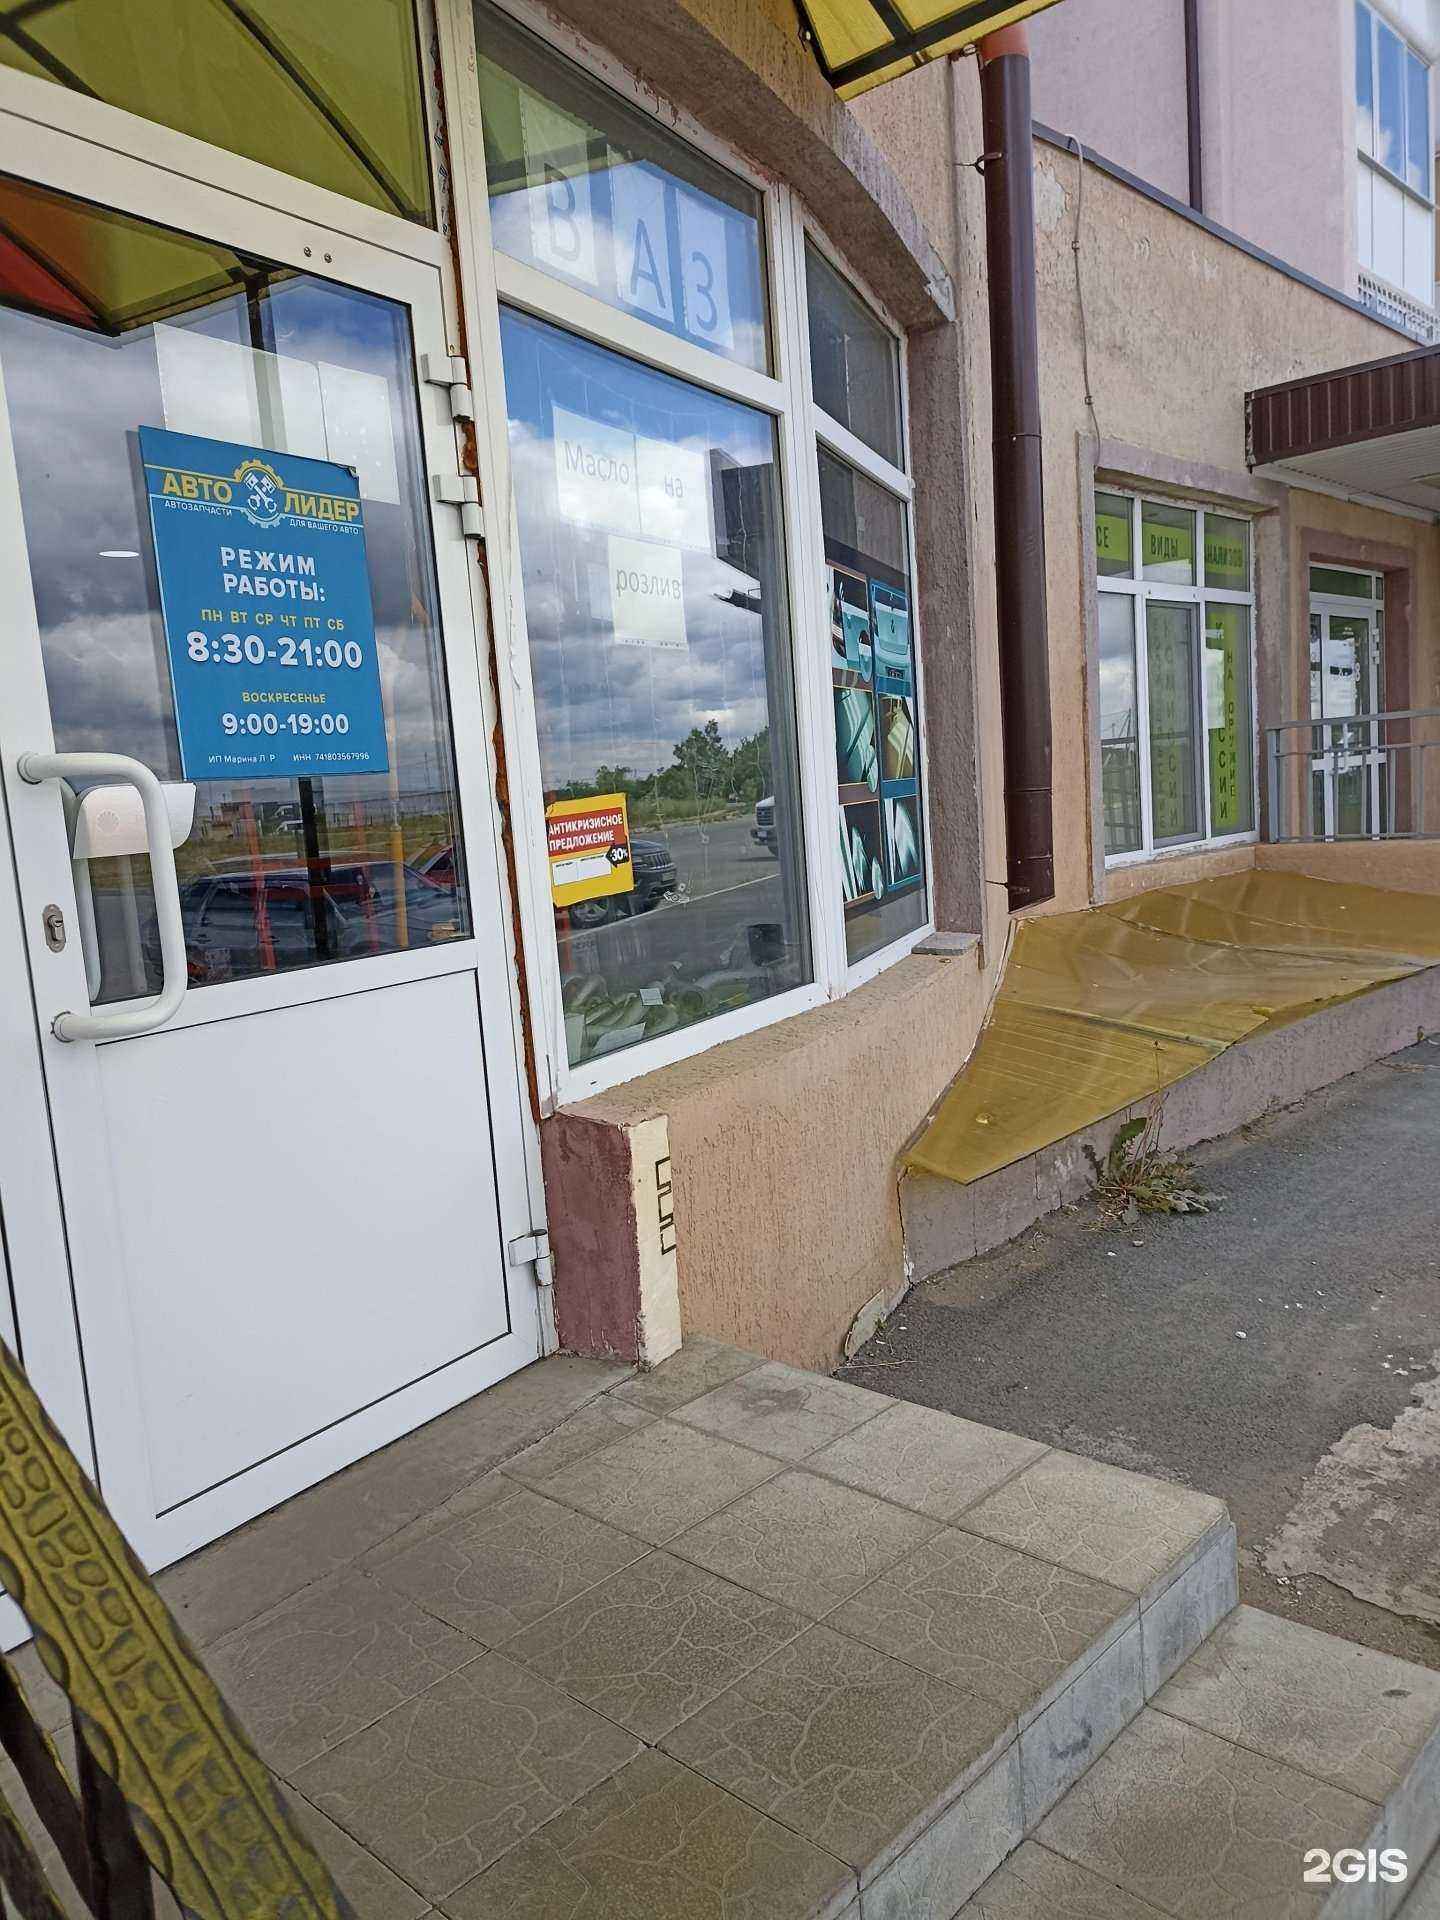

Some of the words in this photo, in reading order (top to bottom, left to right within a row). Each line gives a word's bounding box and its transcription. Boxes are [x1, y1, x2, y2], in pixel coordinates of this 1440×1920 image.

[544, 163, 718, 331] ВАЗ
[564, 439, 630, 485] Масло
[664, 472, 684, 498] на
[163, 472, 232, 504] АВТО
[285, 492, 360, 521] ЛИДЕР
[165, 500, 232, 516] АВТОЗАПЧАСТИ
[289, 519, 306, 527] ДЛЯ
[307, 521, 338, 532] ВАШЕГО
[340, 526, 359, 535] АВТО
[1095, 526, 1109, 548] СЕ
[1151, 534, 1178, 559] ВИДЫ
[220, 546, 316, 577] РЕЖИМ
[223, 573, 326, 602] РАБОТЫ:
[616, 568, 682, 600] розлив
[201, 609, 223, 622] ПН
[230, 610, 248, 624] ВТ
[255, 613, 274, 625] СР
[280, 615, 296, 628] ЧТ
[304, 617, 320, 629] ПТ
[327, 619, 345, 631] СБ
[187, 631, 363, 669] 8:30-21:00
[242, 692, 326, 704] ВОСКРЕСЕНЬЕ
[222, 713, 349, 735] 9:00-19:00
[208, 755, 222, 763] ИП
[224, 755, 257, 765] Марина
[548, 814, 623, 835] АНТИКРИЗИСНОЕ
[549, 830, 615, 851] ПРЕДЛОЖЕНИЕ
